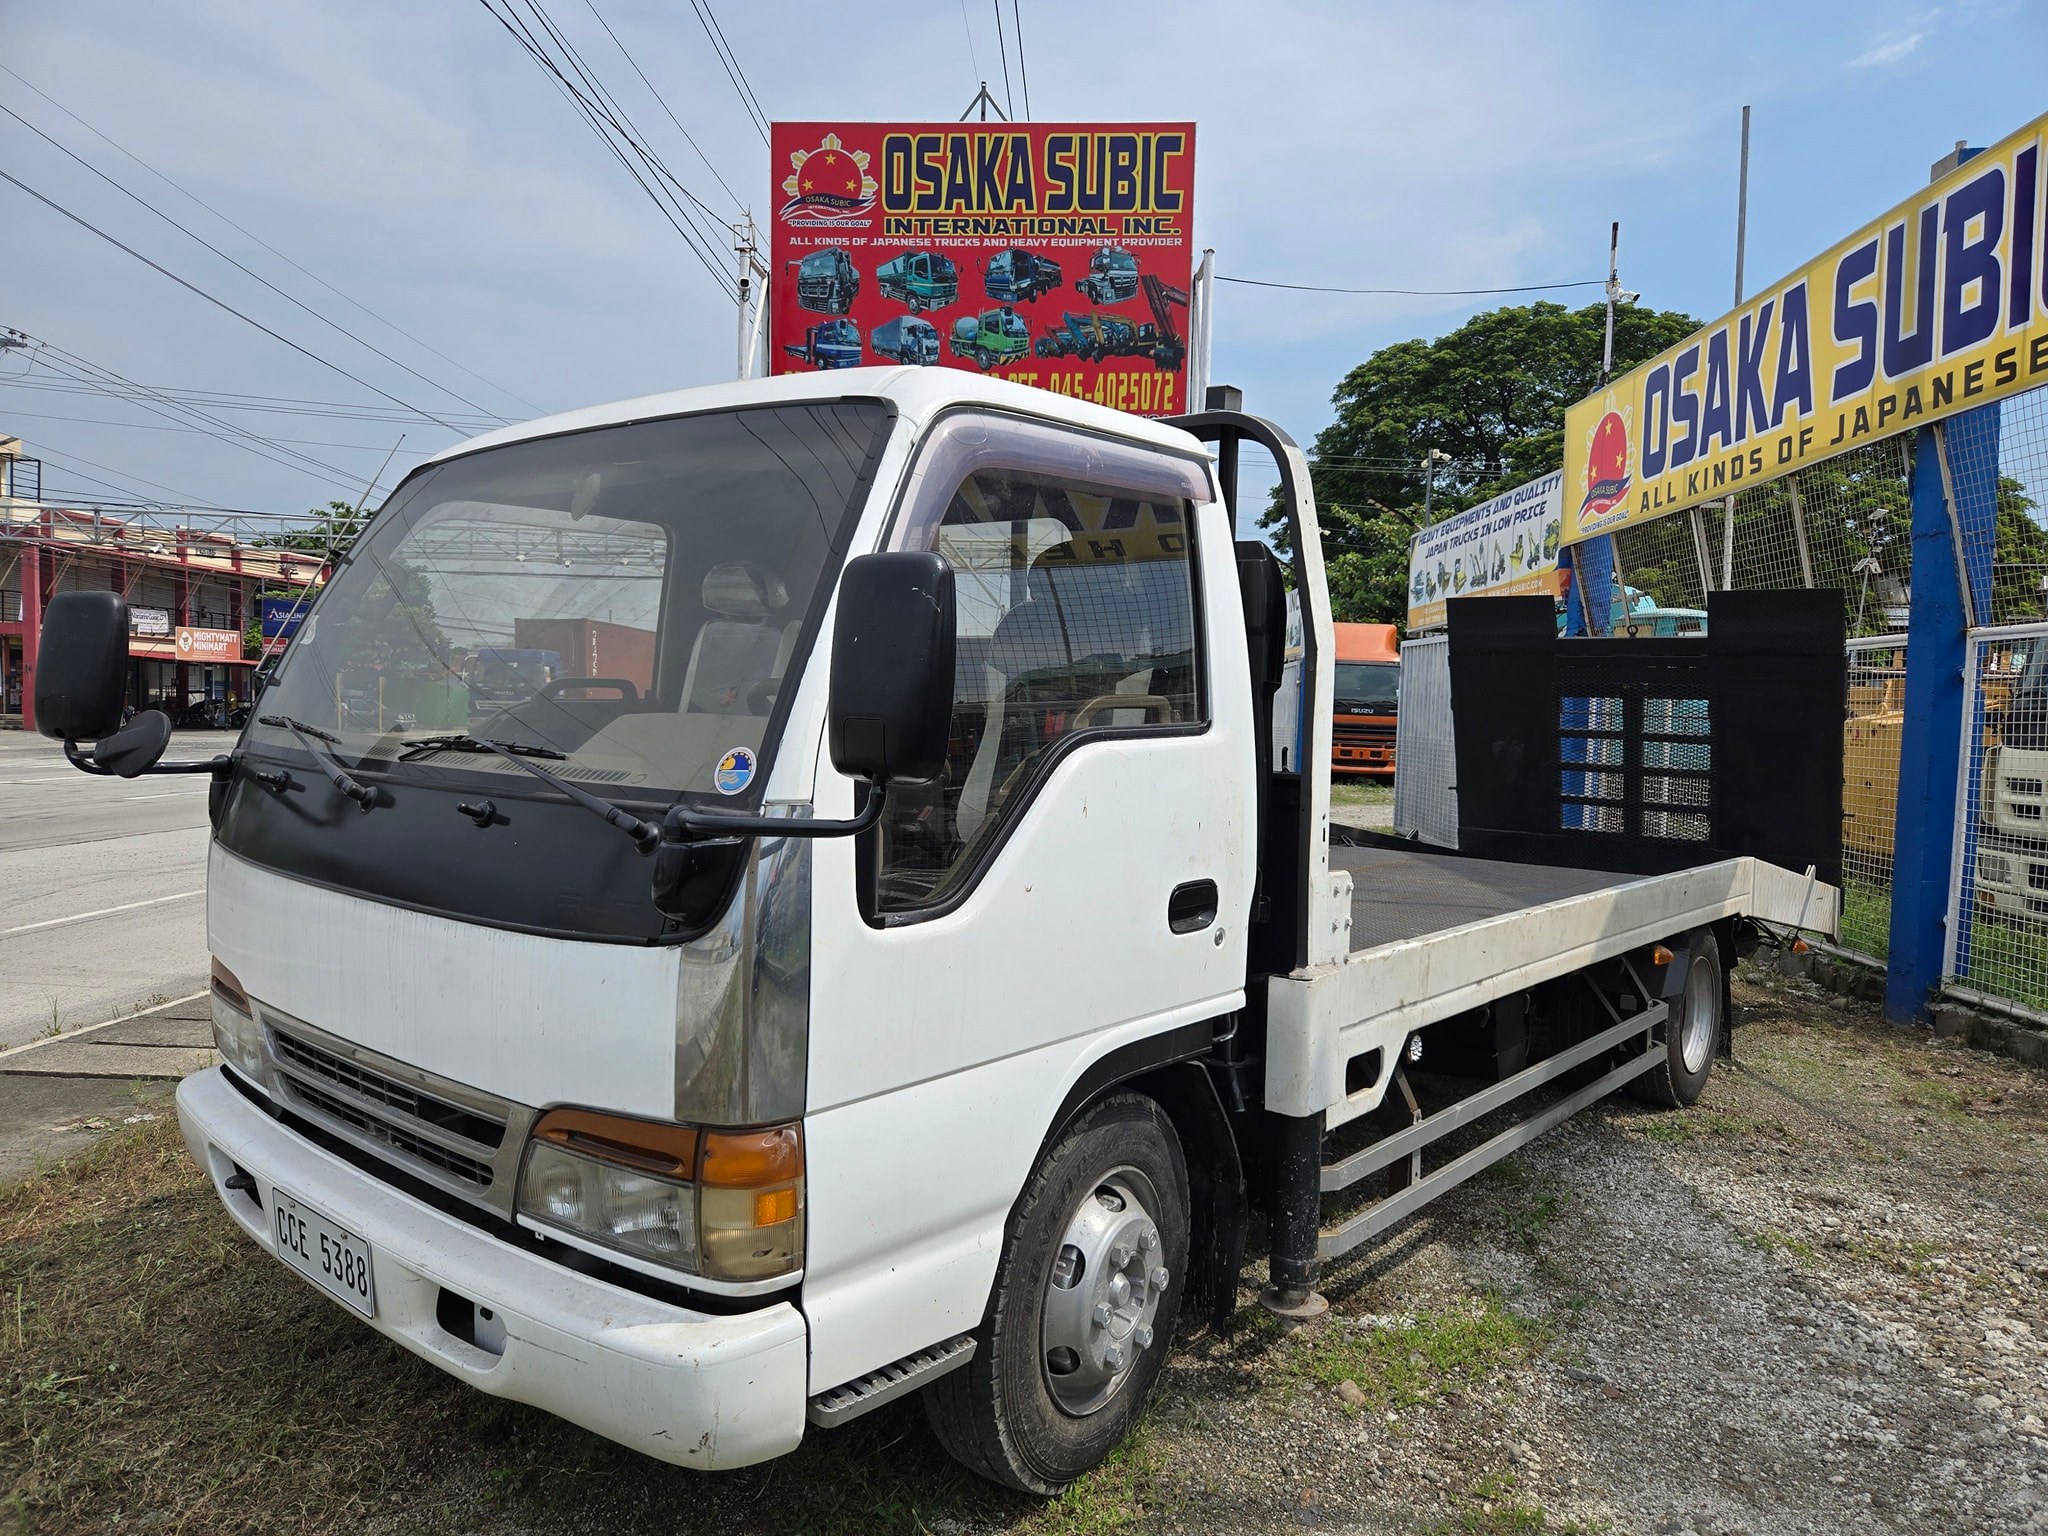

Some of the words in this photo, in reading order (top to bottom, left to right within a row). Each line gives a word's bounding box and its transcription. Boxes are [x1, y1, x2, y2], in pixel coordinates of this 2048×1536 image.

[805, 196, 829, 204] OSAKA
[831, 198, 851, 207] SUBIC
[883, 133, 1037, 213] OSAKA
[1044, 132, 1185, 213] SUBIC
[789, 236, 811, 246] ALL
[814, 237, 850, 246] KINDS
[852, 237, 867, 246] OF
[870, 237, 931, 247] JAPANESE
[934, 238, 979, 247] TRUCKS
[983, 238, 1007, 247] AND
[1010, 238, 1048, 247] HEAVY
[1050, 238, 1119, 247] EQUIPMENT
[1122, 237, 1182, 247] PROVIDER
[884, 217, 1117, 236] INTERNATIONAL
[1123, 216, 1182, 236] INC.
[1642, 280, 1814, 479] OSAKA
[1831, 138, 2048, 404] SUBI
[1639, 481, 1677, 513] ALL
[1688, 447, 1762, 496] KINDS
[1778, 426, 1814, 465] OF
[1829, 334, 2048, 447] JAPANESE
[1418, 526, 1441, 547] HEAVY
[1440, 503, 1492, 537] EQUIPMENTS
[1492, 496, 1513, 515] AND
[1513, 474, 1562, 506] QUALITY
[1425, 542, 1448, 559] JAPAN
[1449, 528, 1479, 549] TRUCKS
[1480, 522, 1491, 538] IN
[1492, 514, 1513, 533] LOW
[1513, 500, 1547, 525] PRICE
[193, 631, 238, 643] MIGHTYMATT
[193, 641, 228, 651] MINIMART
[277, 1206, 310, 1261] CCE
[320, 1231, 368, 1297] 5388
